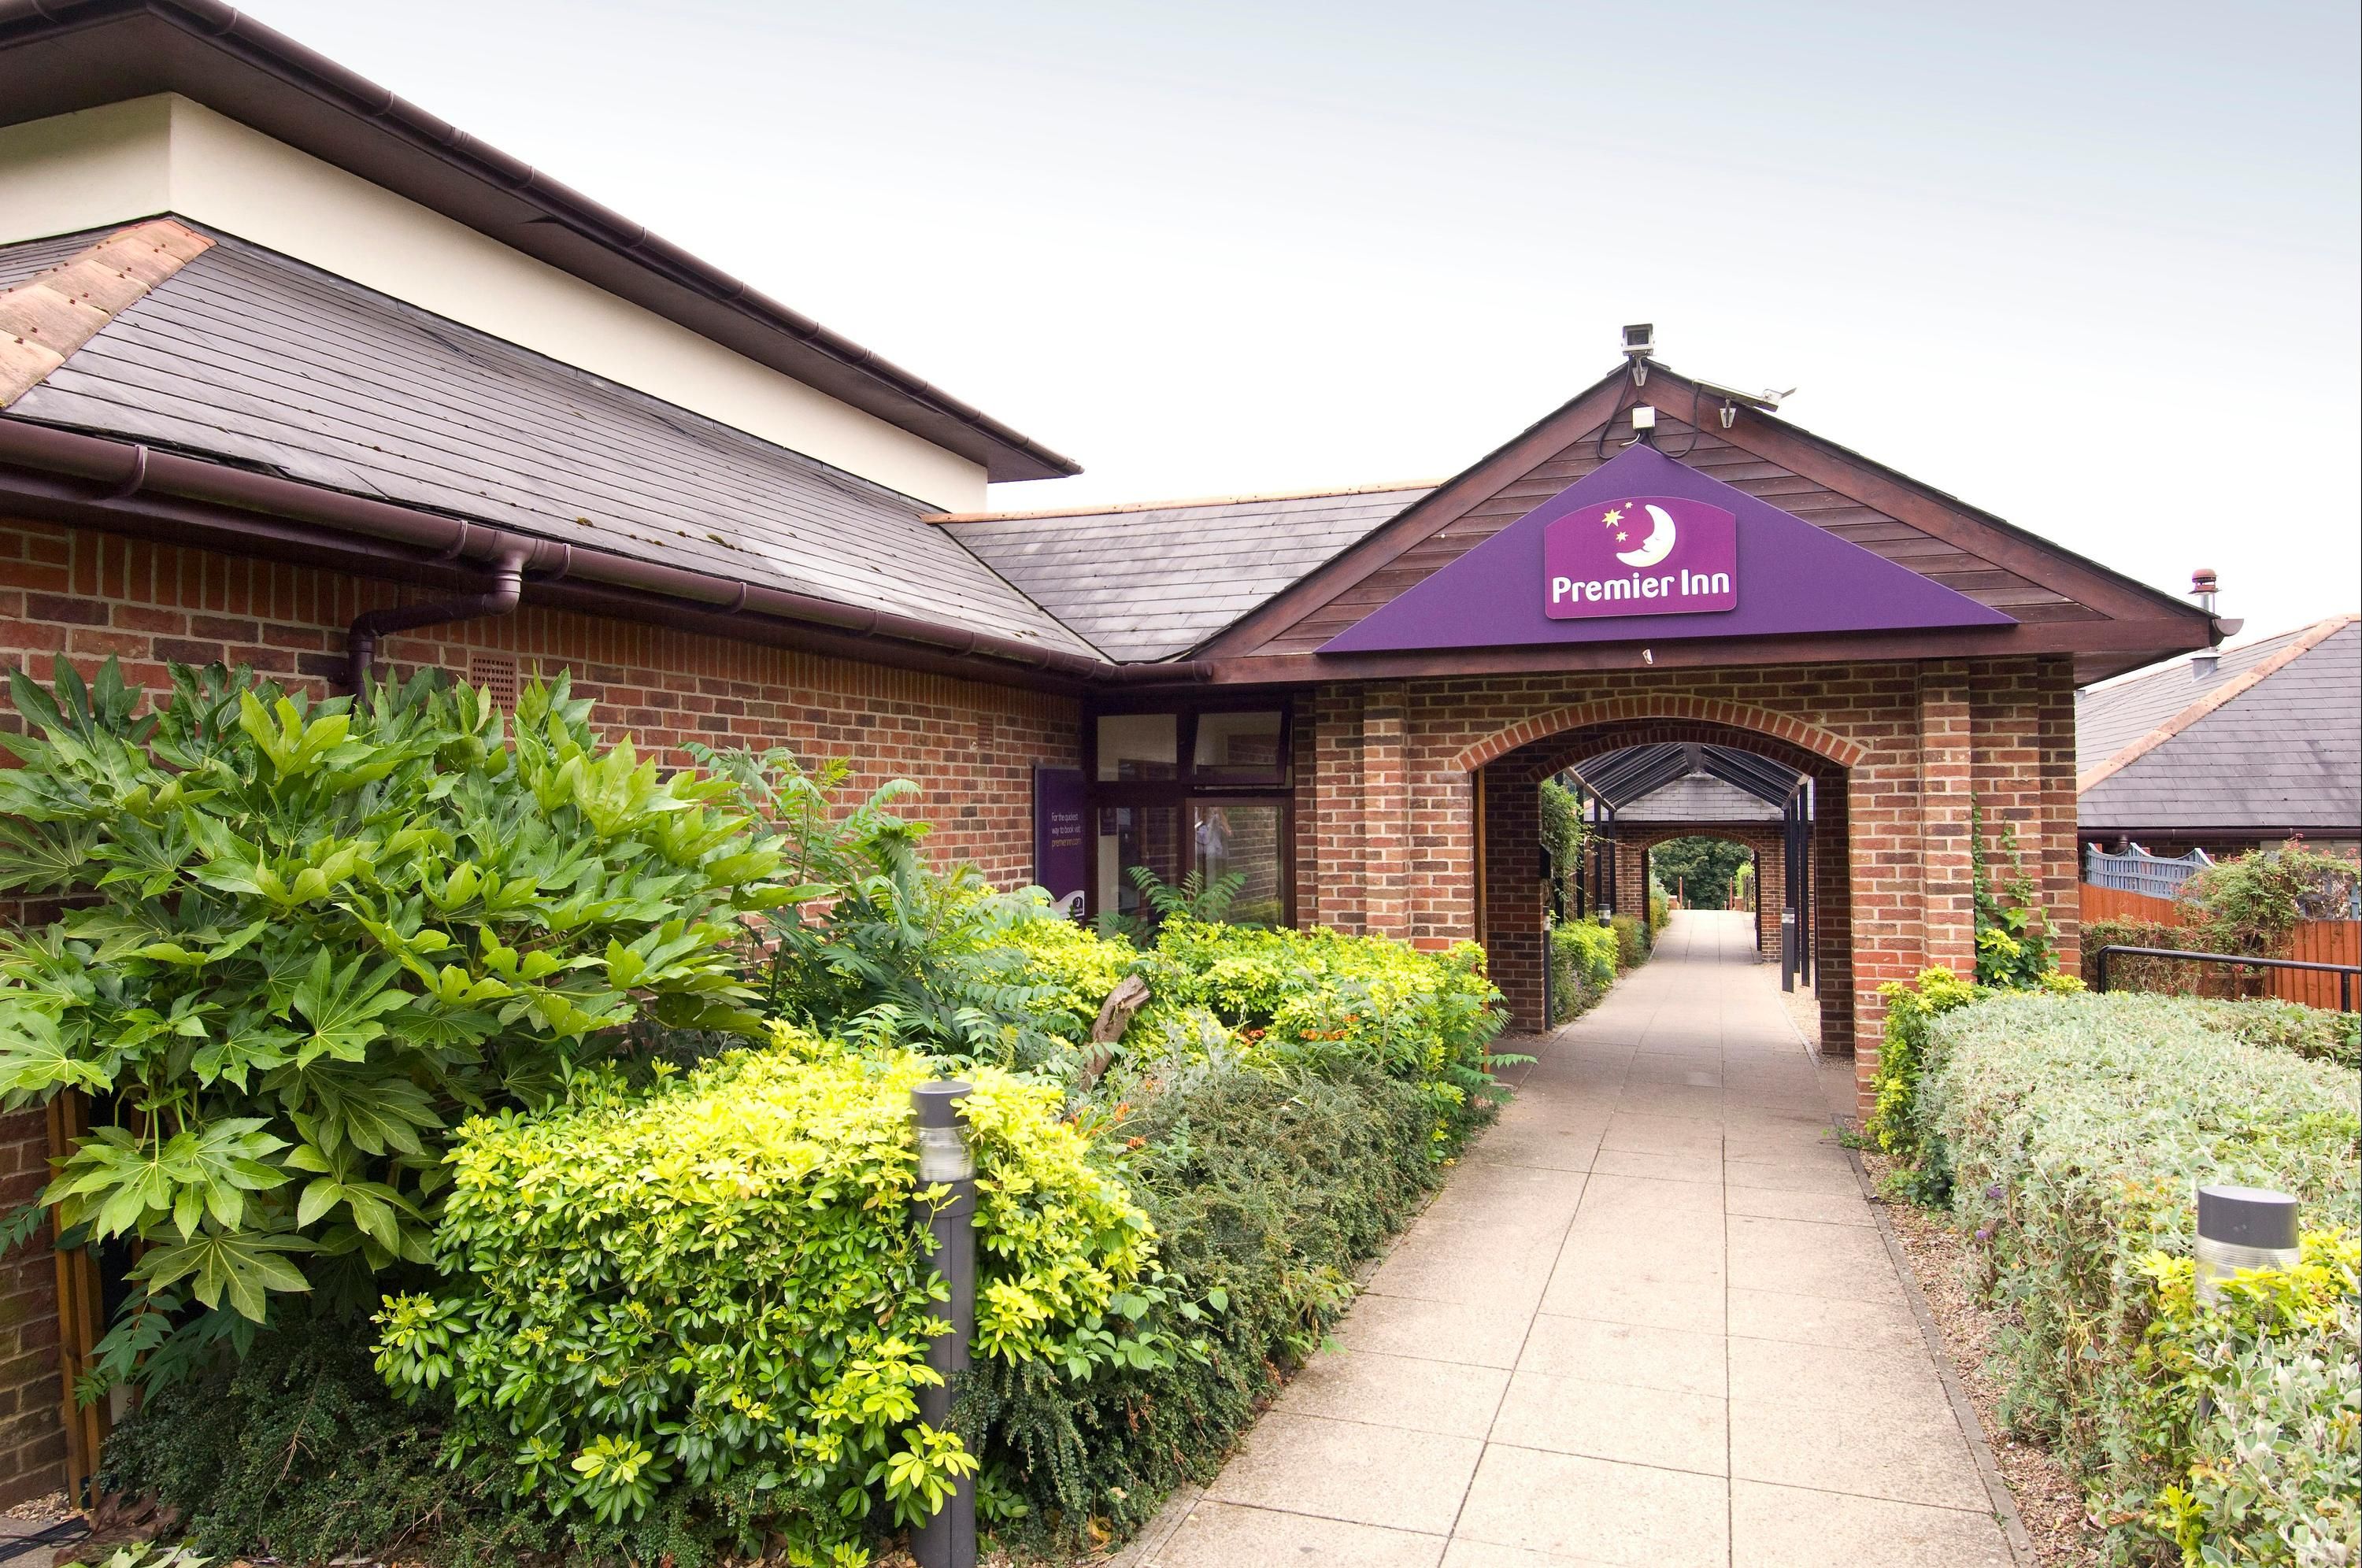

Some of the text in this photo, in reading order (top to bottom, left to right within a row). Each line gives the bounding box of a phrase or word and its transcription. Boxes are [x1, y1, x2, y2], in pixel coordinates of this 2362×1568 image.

[1553, 569, 1730, 603] Premier Inn
[1064, 825, 1074, 834] book
